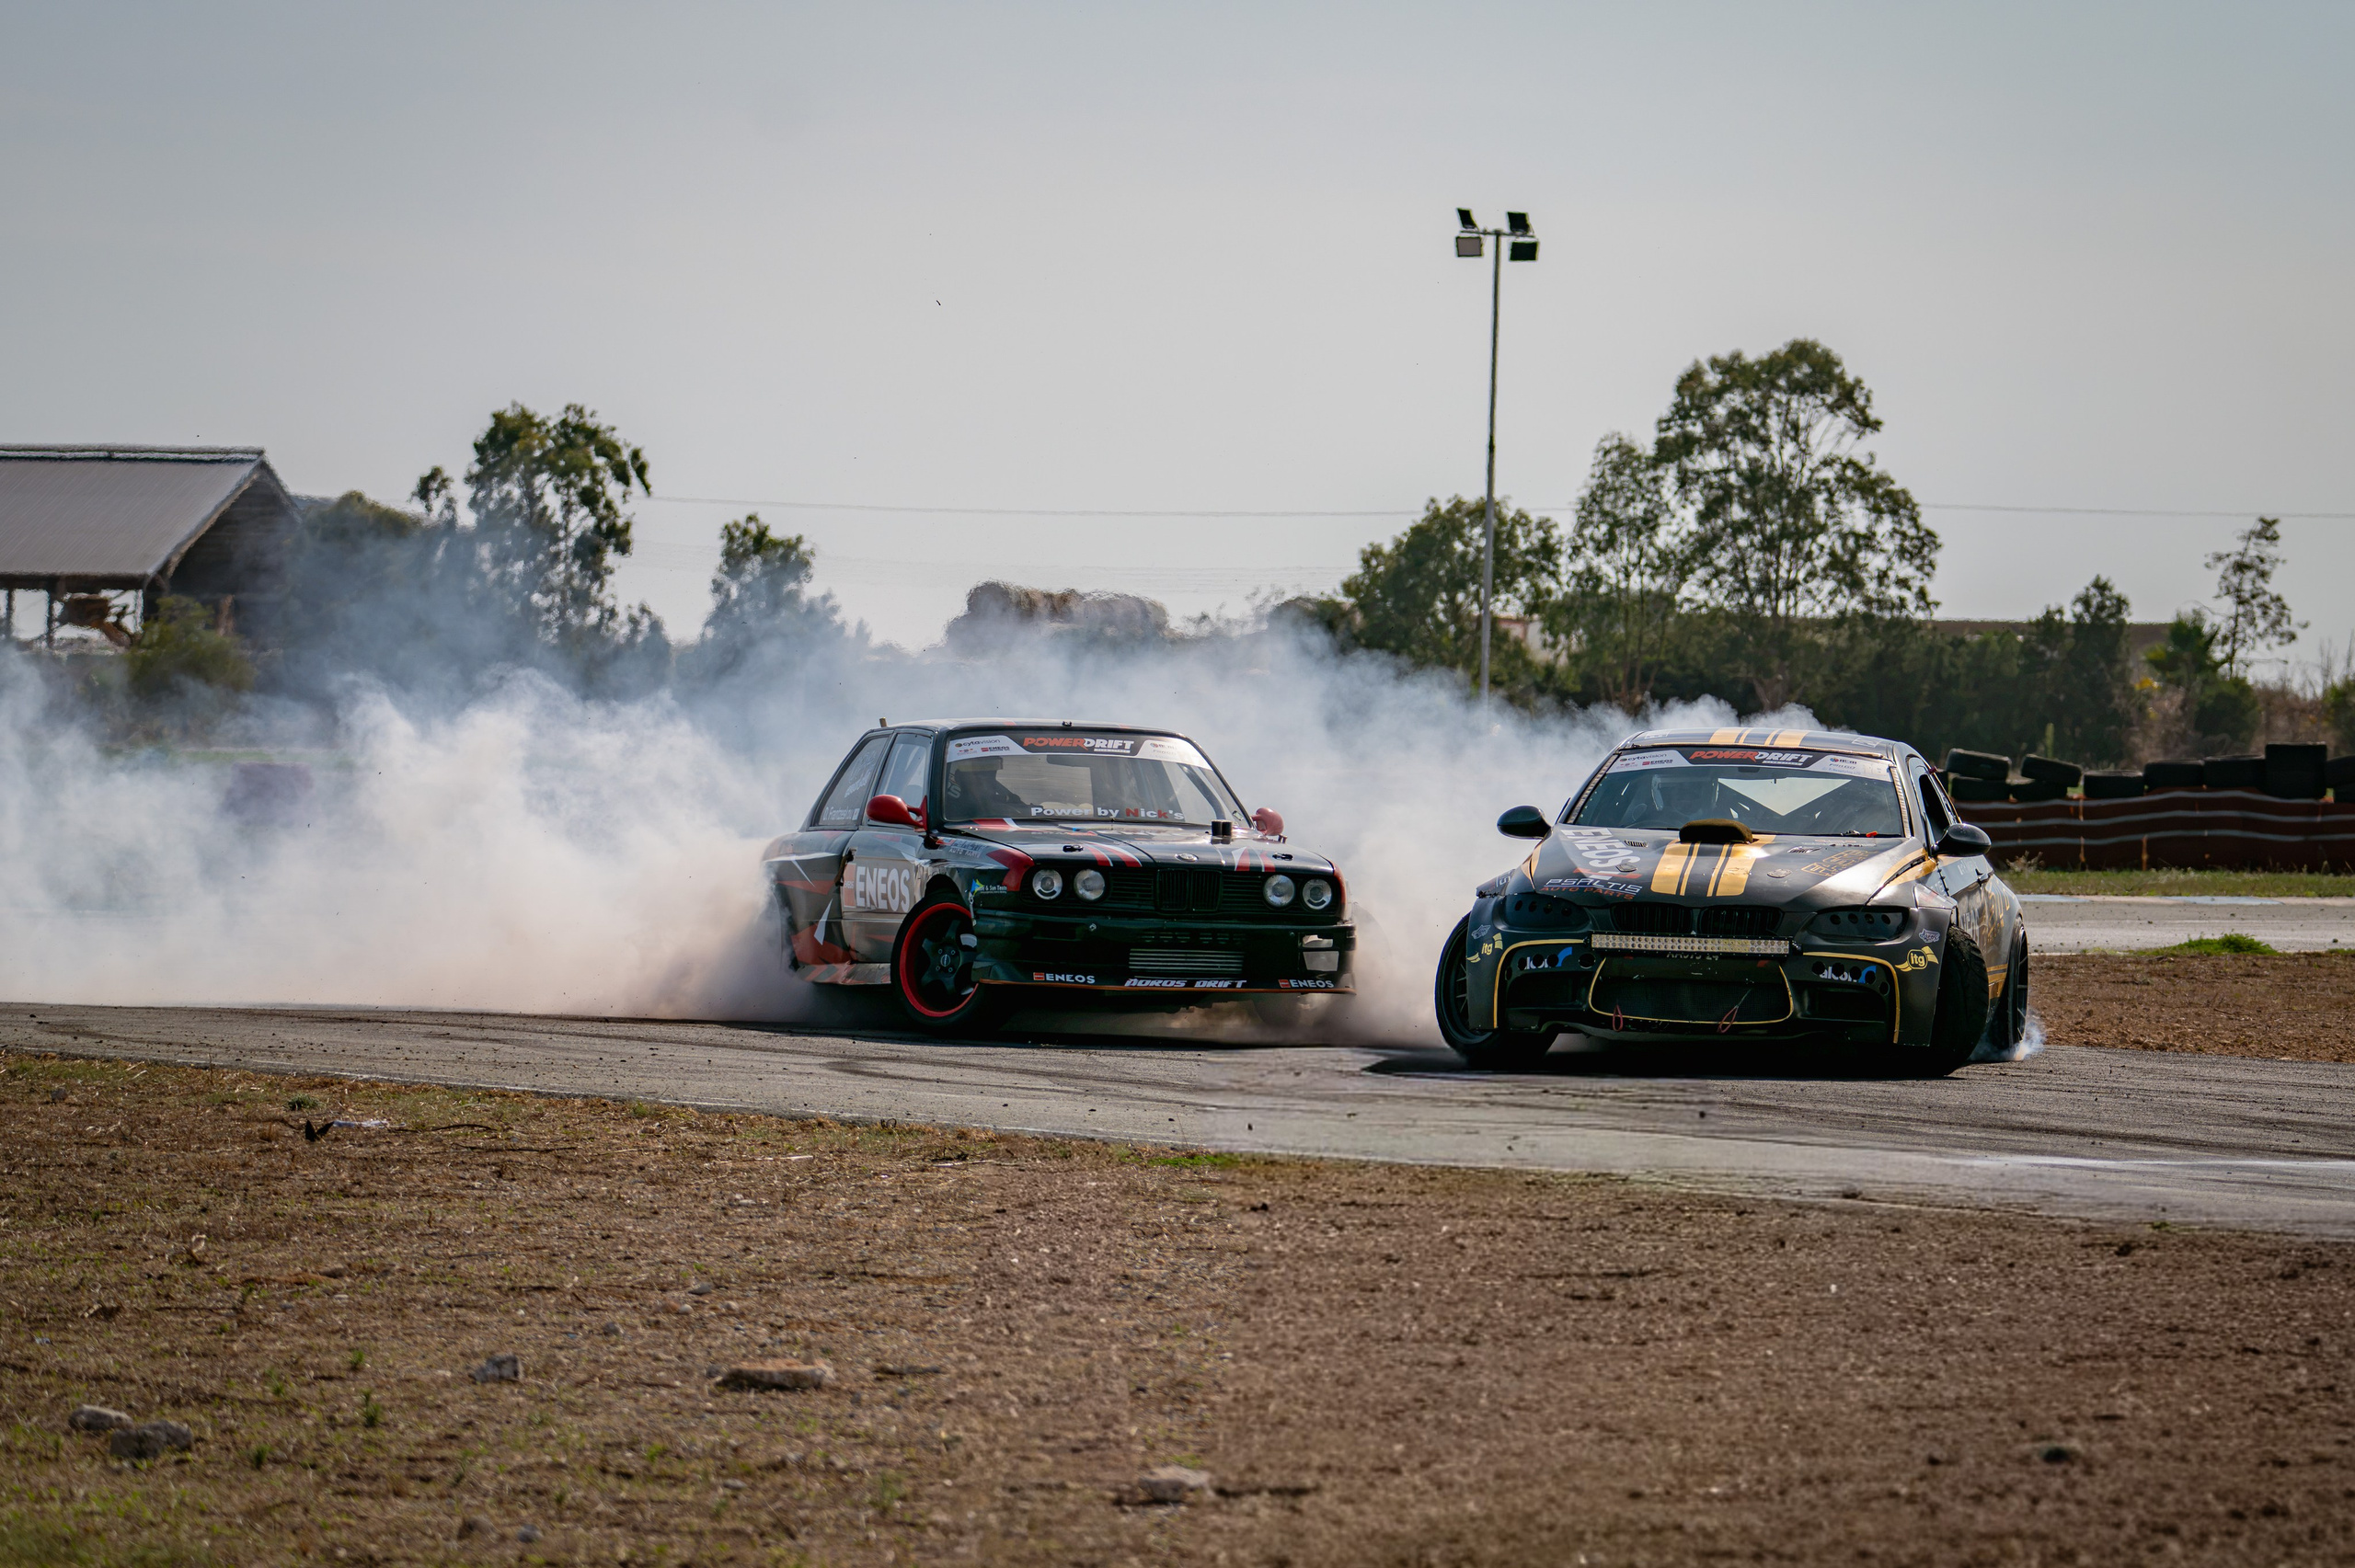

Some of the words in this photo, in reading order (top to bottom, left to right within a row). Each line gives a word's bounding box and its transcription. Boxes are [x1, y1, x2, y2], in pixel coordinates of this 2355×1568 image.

[962, 738, 1001, 747] cytavision
[1023, 737, 1134, 750] POWERDRIFT
[1689, 750, 1813, 762] POWERDRIFT
[1030, 807, 1091, 817] Power
[1097, 807, 1120, 818] by
[1125, 807, 1185, 820] Nick's
[1560, 828, 1641, 868] ENEOS
[856, 865, 911, 912] ENEOS
[1545, 878, 1643, 893] PSALTIS
[1584, 887, 1637, 900] PARTS
[1481, 943, 1493, 956] itg
[1910, 953, 1925, 966] itg
[1045, 973, 1096, 984] ENEOS
[1194, 979, 1247, 988] DRIFT
[1290, 979, 1334, 989] ENEOS
